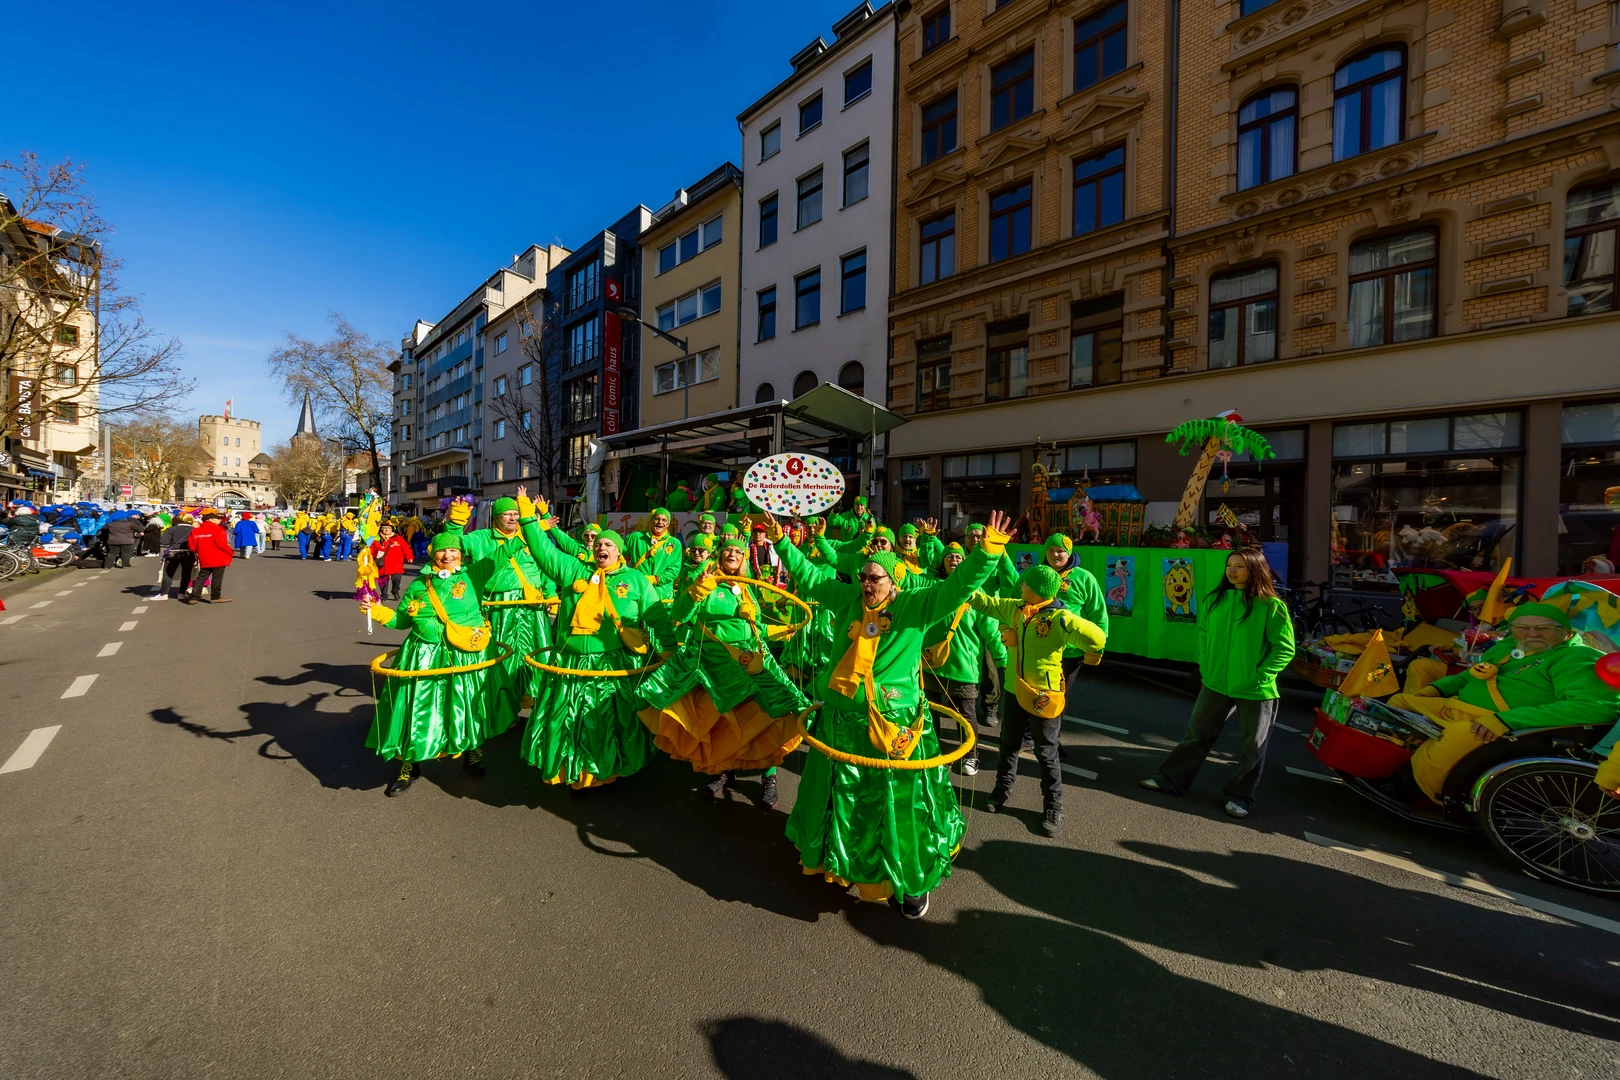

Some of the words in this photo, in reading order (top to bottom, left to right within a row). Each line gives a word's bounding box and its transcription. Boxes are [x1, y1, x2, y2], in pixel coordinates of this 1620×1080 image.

[608, 347, 617, 371] haus
[608, 377, 617, 406] comic
[608, 411, 616, 432] cöln
[791, 461, 798, 471] 4
[914, 465, 928, 480] 15
